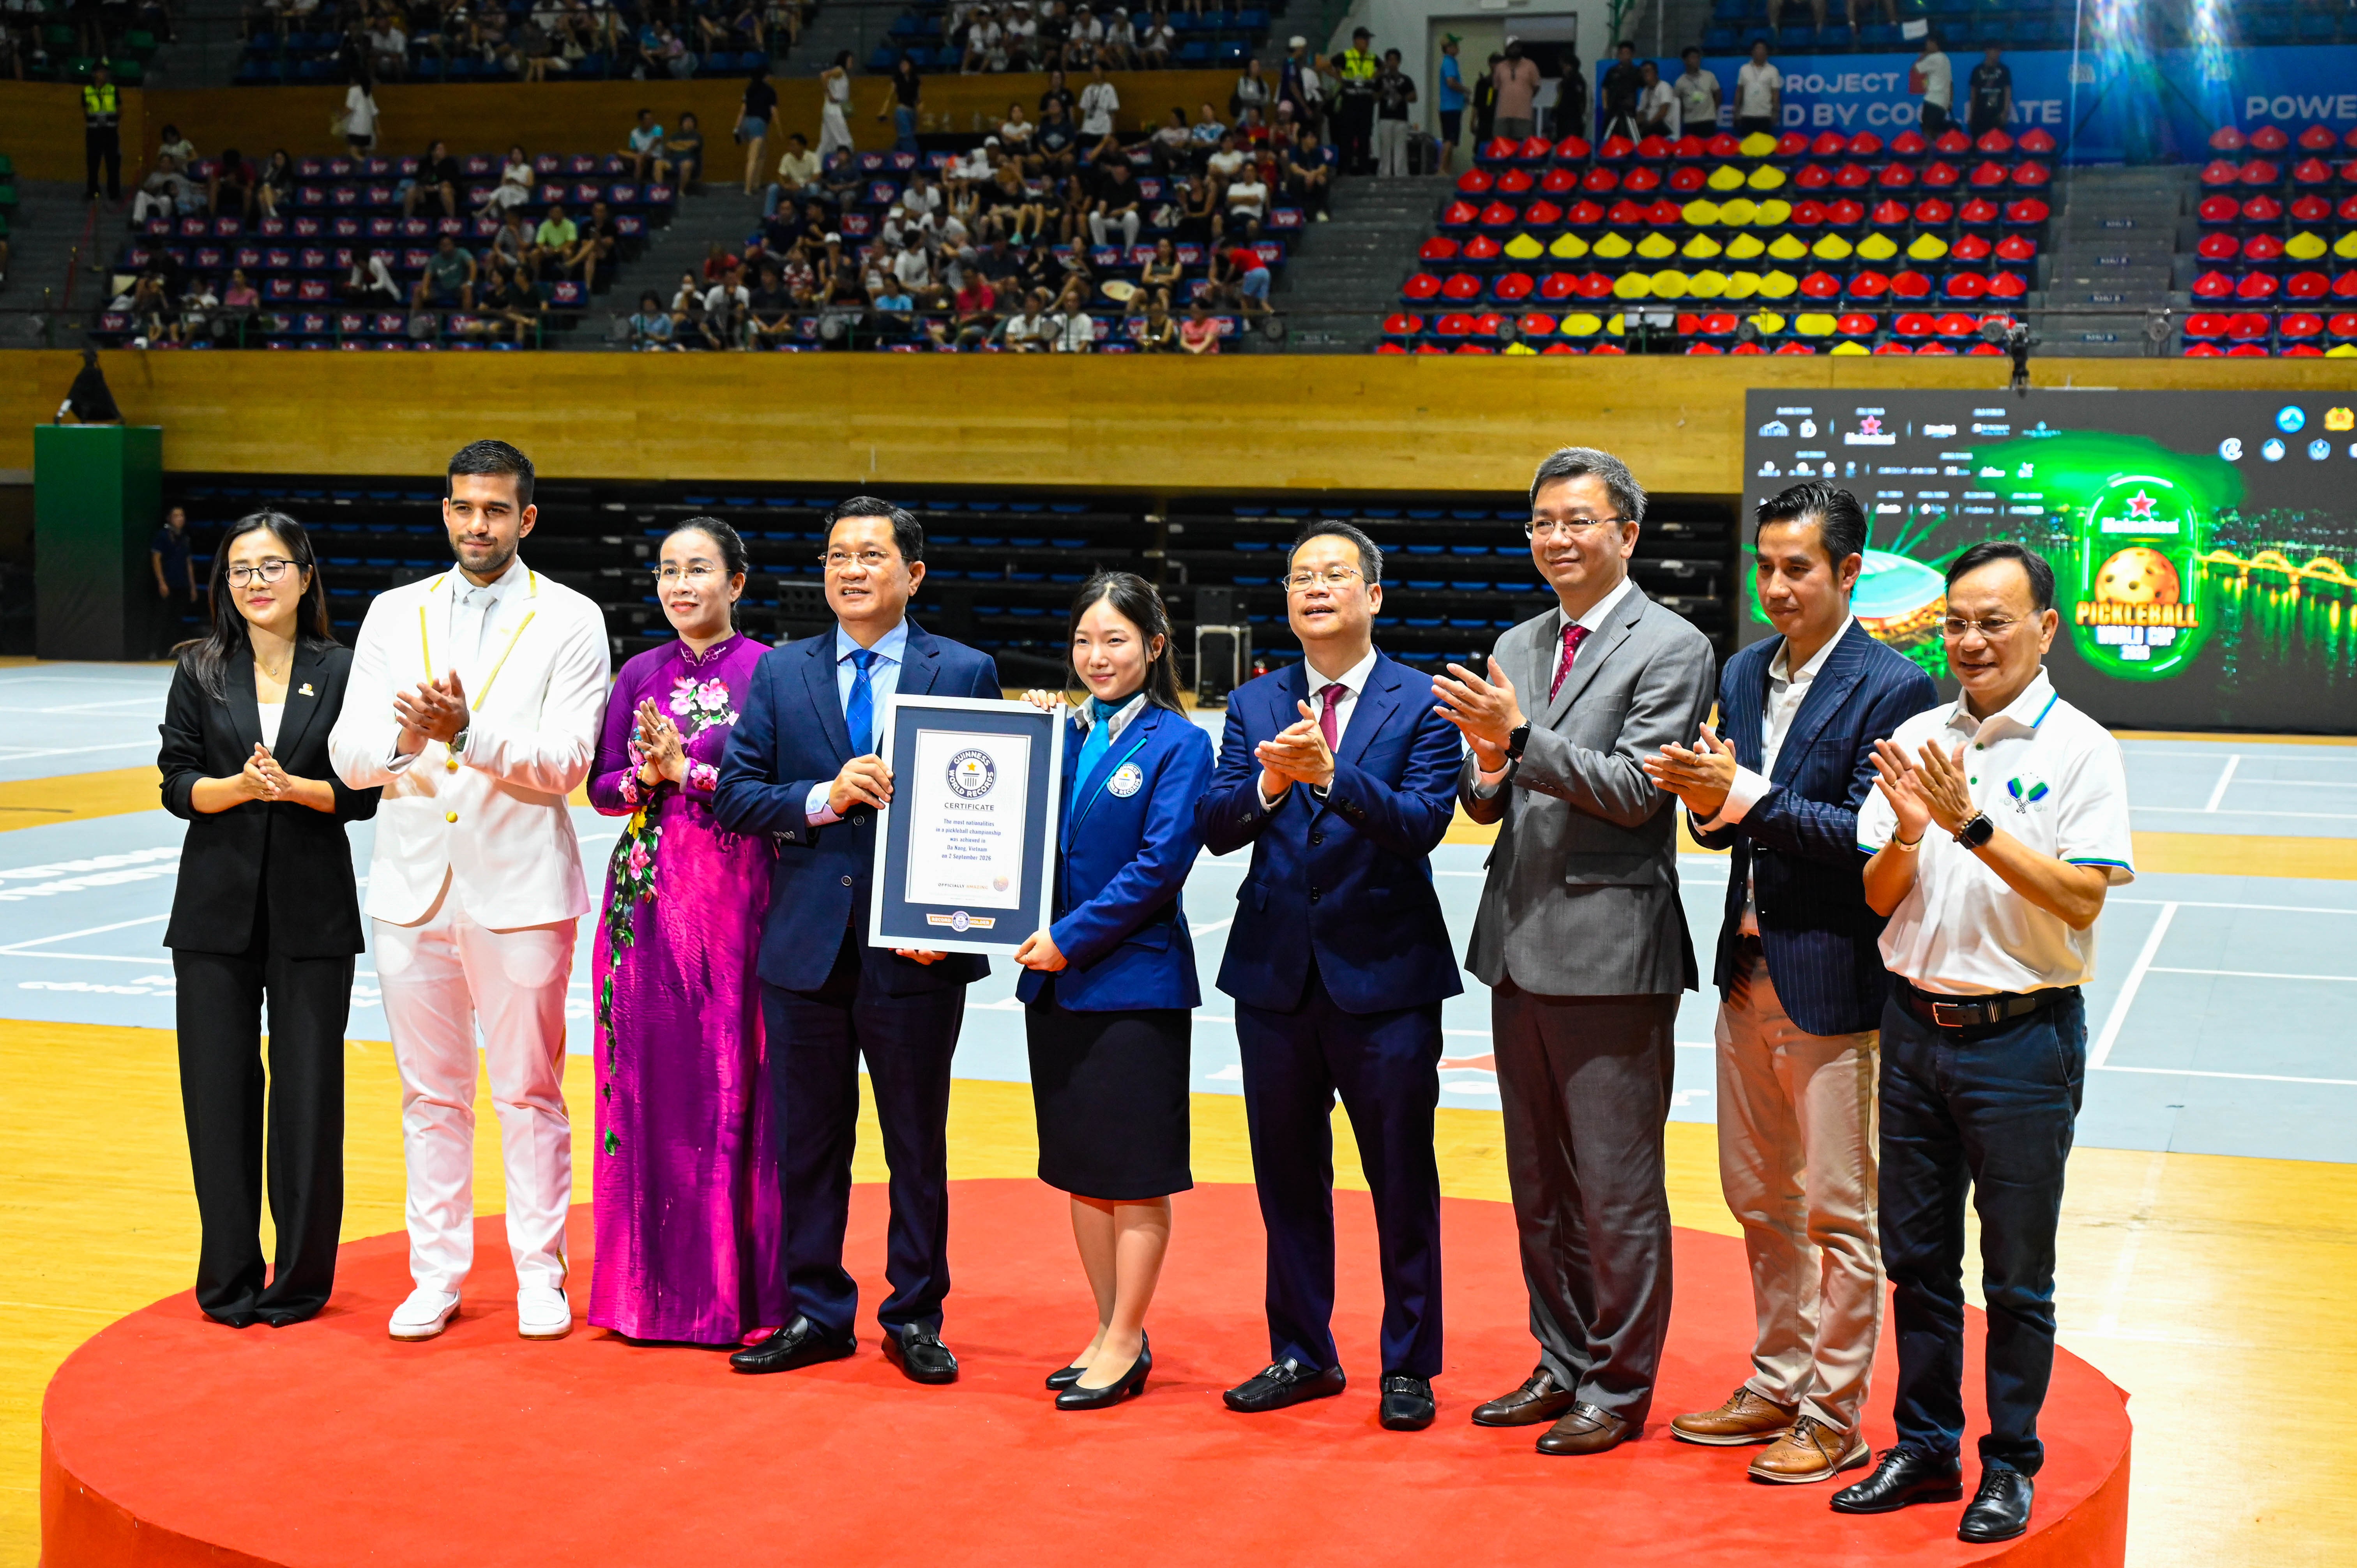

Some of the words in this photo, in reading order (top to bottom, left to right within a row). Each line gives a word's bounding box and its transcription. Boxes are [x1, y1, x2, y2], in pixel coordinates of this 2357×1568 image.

[1780, 72, 1899, 94] ROJECT
[1813, 103, 1859, 126] BY
[1141, 185, 1161, 195] VIP
[1277, 214, 1298, 224] VIP
[1096, 254, 1117, 265] VIP
[1178, 251, 1198, 262] VIP
[1257, 250, 1278, 260] VIP
[2076, 601, 2199, 627] PICKLEBALL
[954, 751, 991, 766] GUINNESS
[949, 769, 965, 795] WORLD
[966, 772, 994, 797] RECORDS
[944, 802, 994, 810] CERTIFICATE
